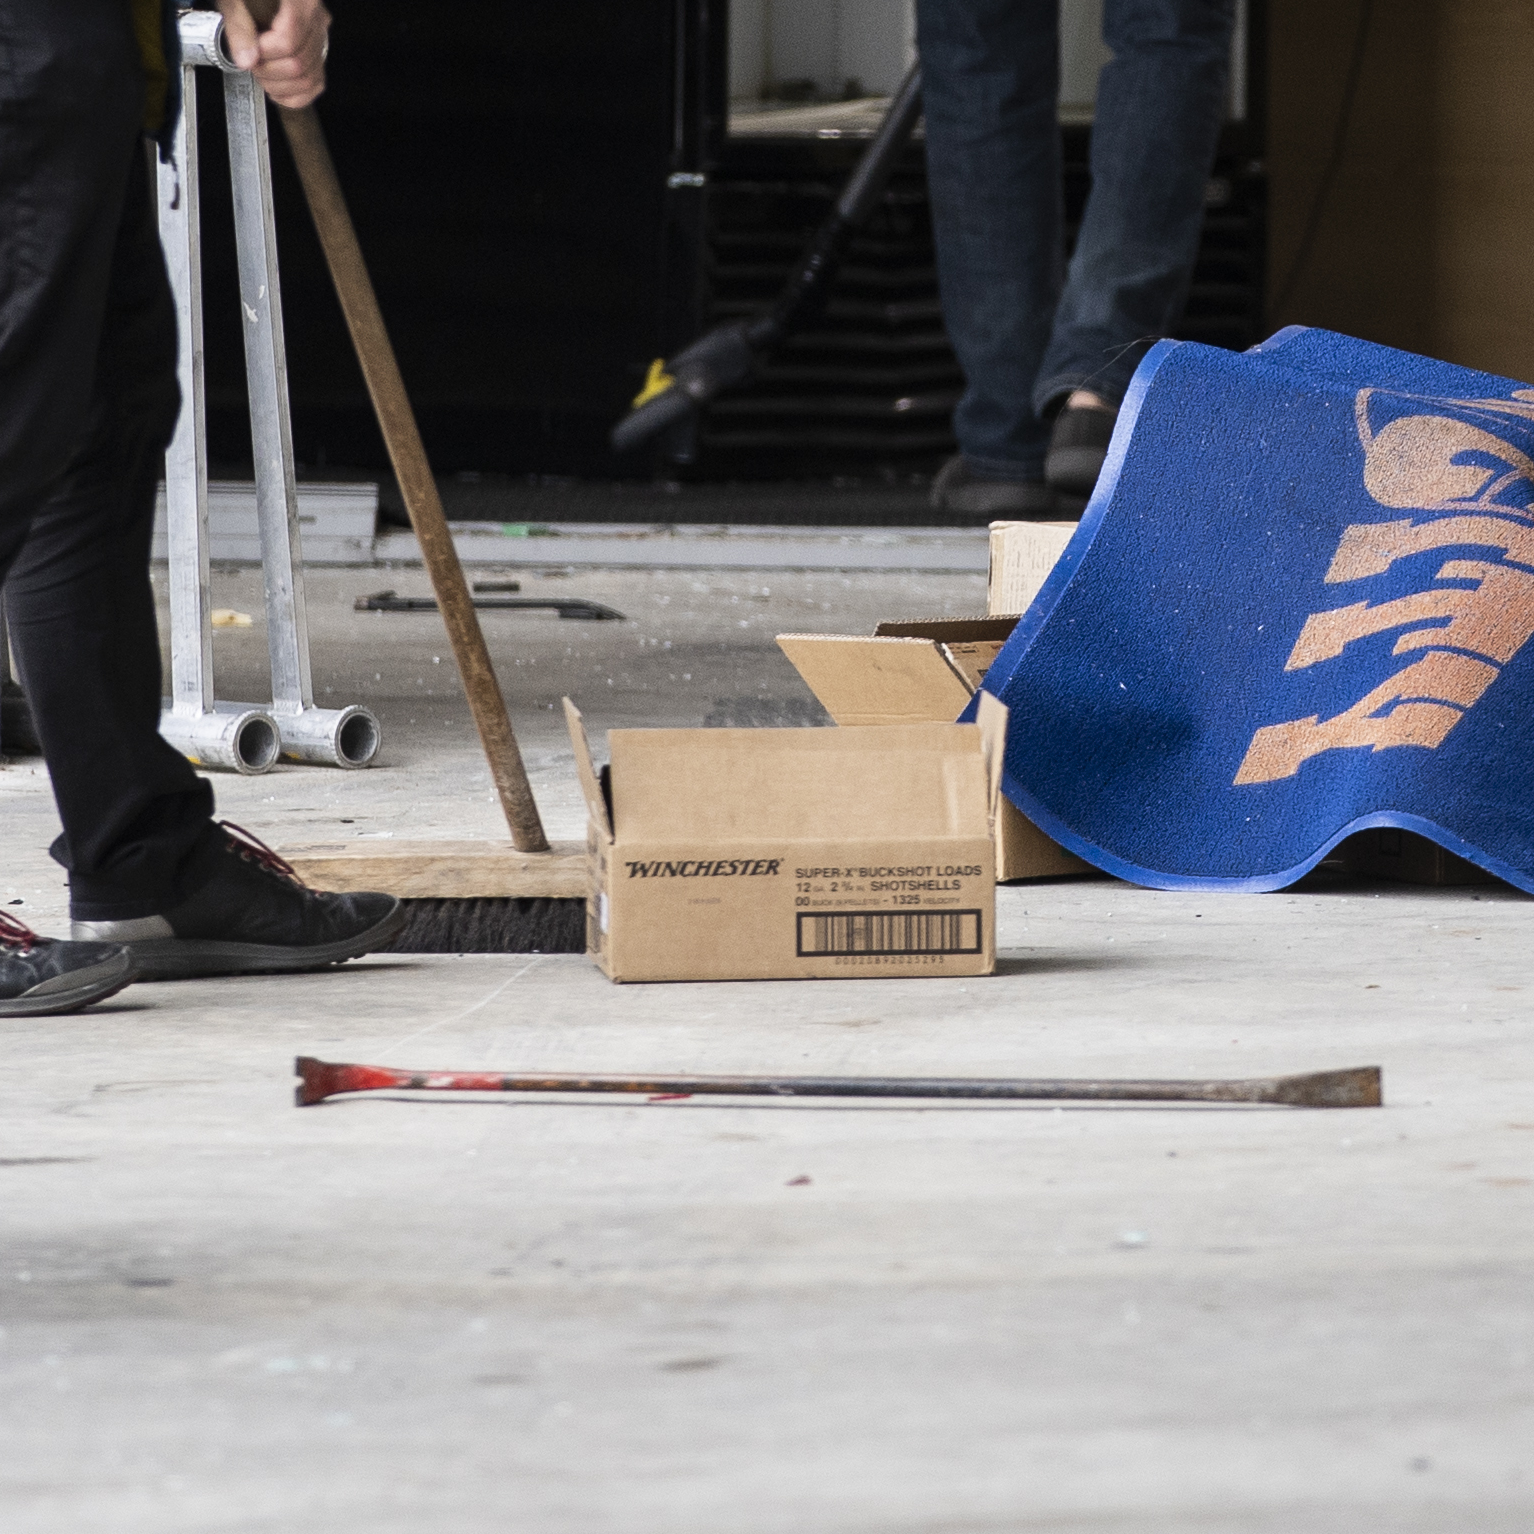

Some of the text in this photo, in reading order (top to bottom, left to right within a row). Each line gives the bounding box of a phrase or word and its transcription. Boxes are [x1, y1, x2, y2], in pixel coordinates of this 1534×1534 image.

[624, 858, 781, 878] WINCHESTER
[859, 866, 933, 878] BUCKSHOT
[936, 864, 982, 877] LOADS
[796, 881, 811, 892] 12
[830, 881, 839, 892] 2
[870, 879, 961, 892] SHOTSHELLS
[892, 894, 920, 905] 1325
